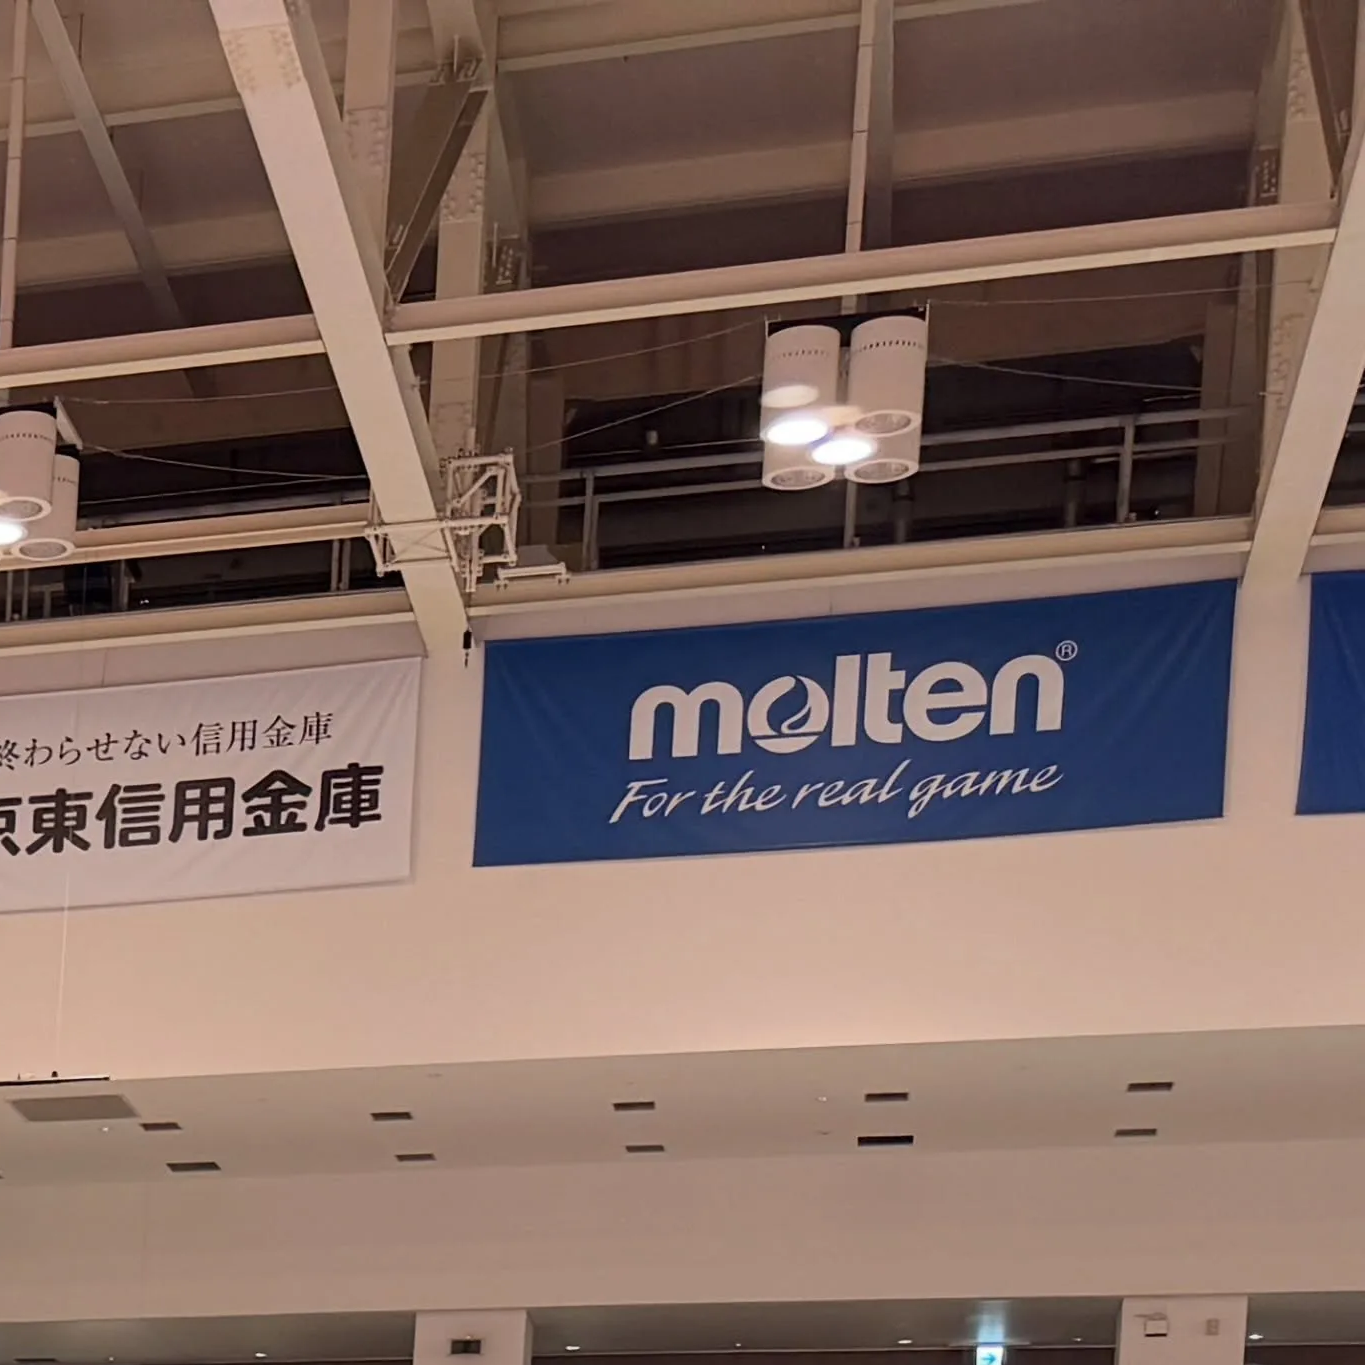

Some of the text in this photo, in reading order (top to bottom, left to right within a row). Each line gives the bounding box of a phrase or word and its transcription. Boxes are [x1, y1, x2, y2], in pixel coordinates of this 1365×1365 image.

[609, 758, 1065, 824] For the real game
